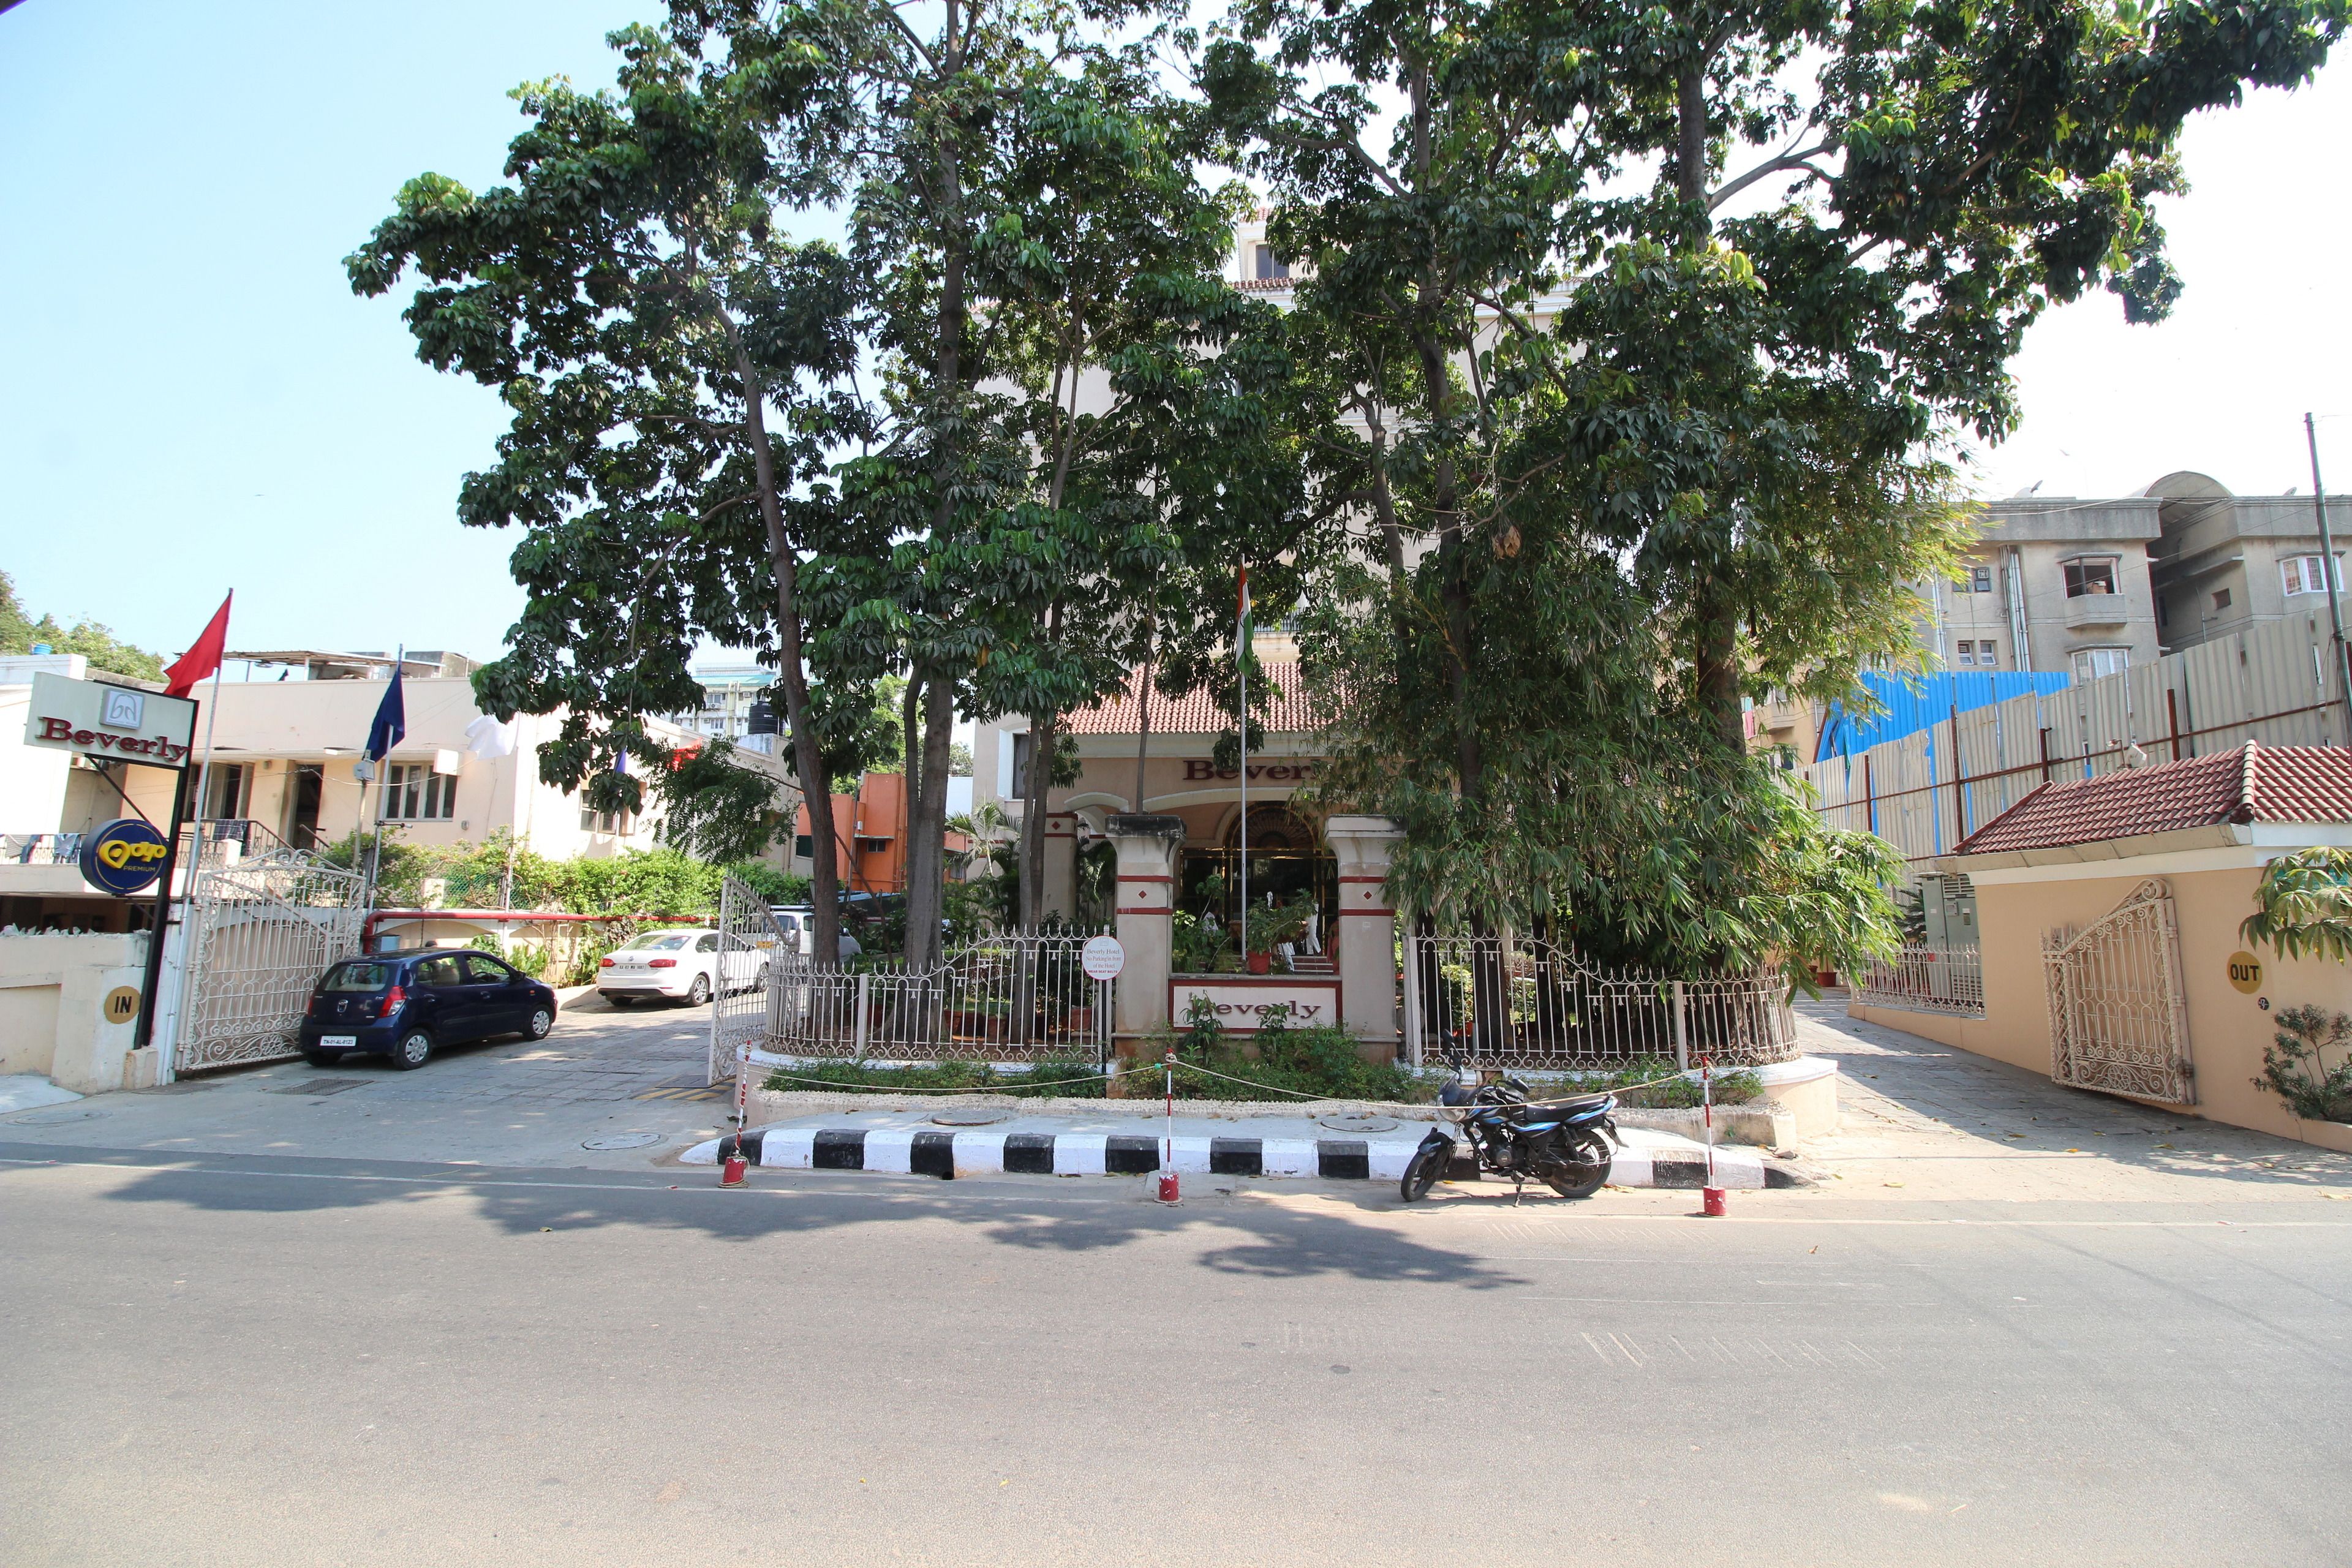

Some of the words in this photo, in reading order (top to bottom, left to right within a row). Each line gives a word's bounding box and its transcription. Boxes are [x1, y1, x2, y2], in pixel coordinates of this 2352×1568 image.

[36, 716, 189, 762] Beverly
[2230, 963, 2259, 981] OUT
[115, 996, 132, 1013] IN
[1188, 1000, 1321, 1019] evely
